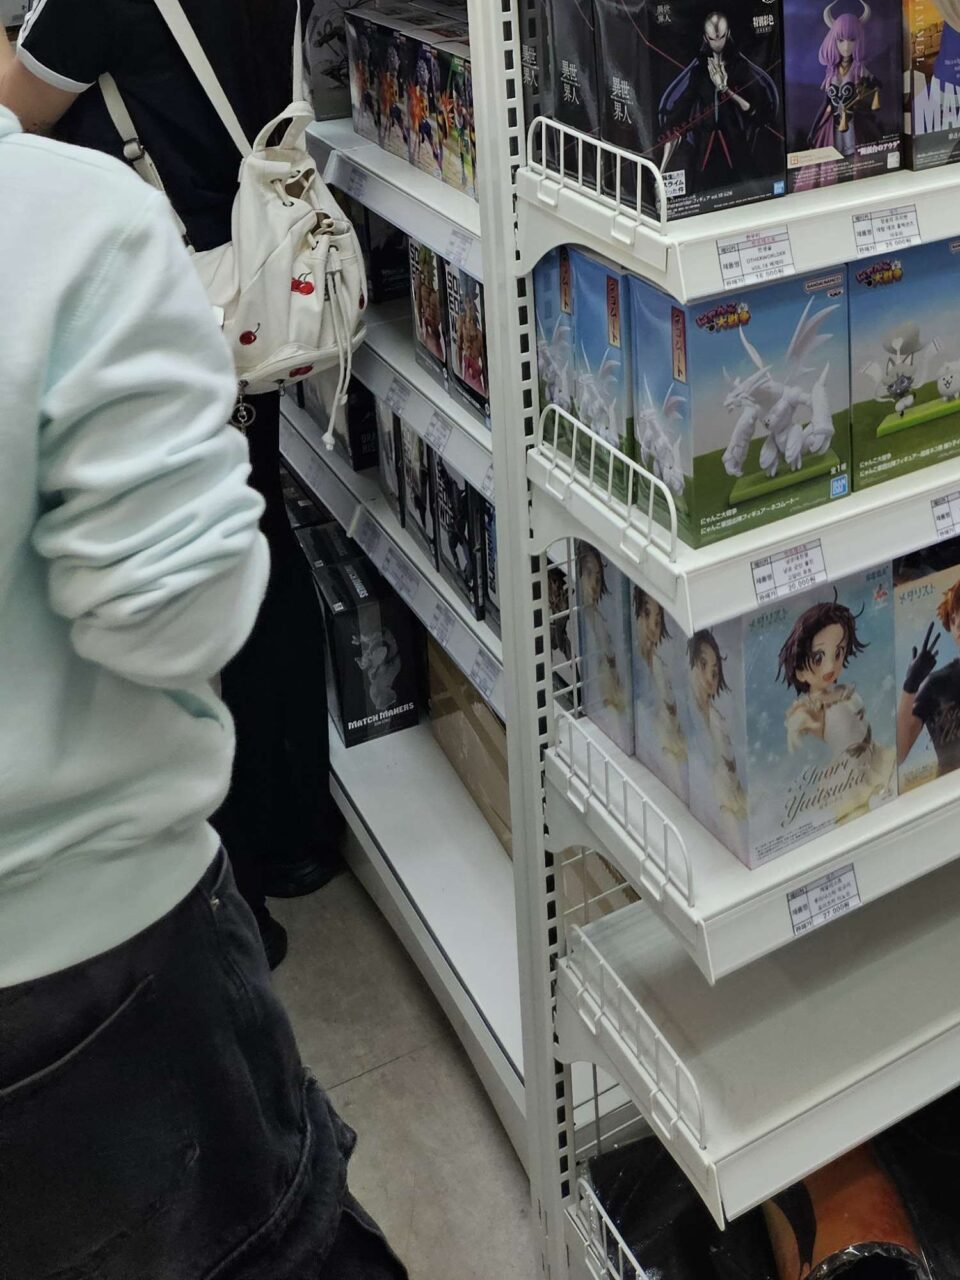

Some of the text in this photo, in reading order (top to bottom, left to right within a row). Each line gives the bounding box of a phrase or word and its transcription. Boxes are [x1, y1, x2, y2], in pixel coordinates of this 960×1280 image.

[614, 101, 632, 124] 界人
[898, 583, 936, 603] メダリスト
[348, 701, 415, 730] MATCH MAKERS
[823, 902, 850, 919] 27,000원
